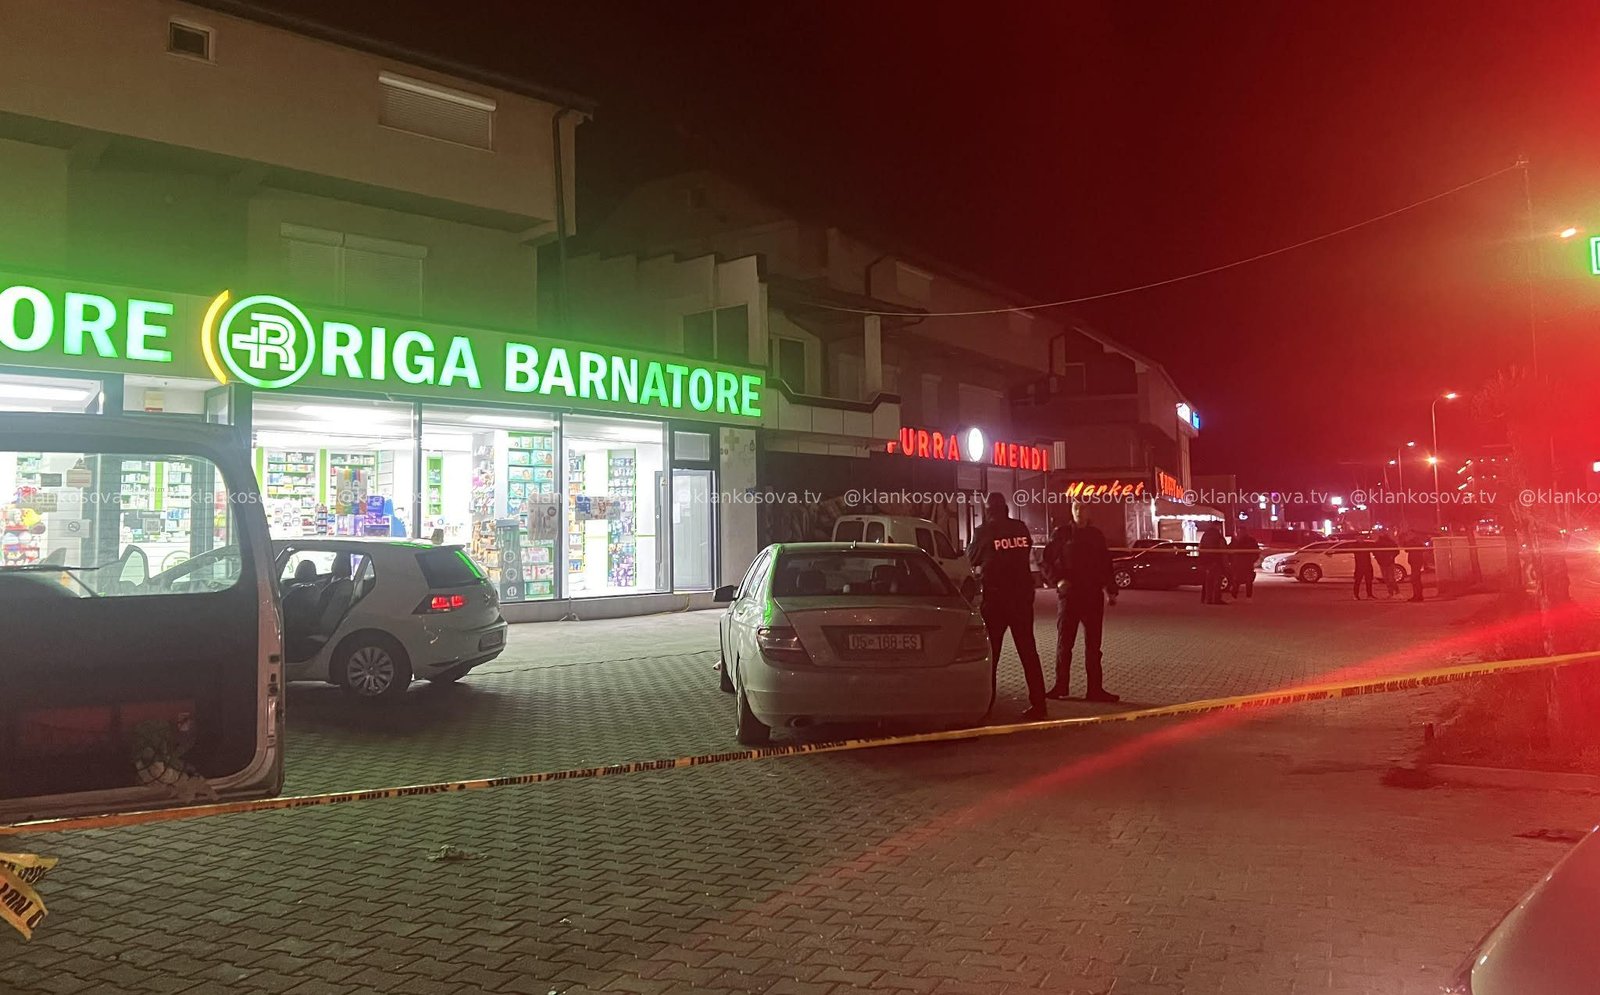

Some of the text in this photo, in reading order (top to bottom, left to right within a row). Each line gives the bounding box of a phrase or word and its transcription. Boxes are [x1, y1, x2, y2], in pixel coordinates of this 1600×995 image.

[0, 285, 174, 362] ORE
[321, 321, 763, 417] RIGA BARNATORE
[994, 442, 1048, 472] MENDI
[1066, 479, 1145, 497] Market
[994, 536, 1029, 550] POLICE
